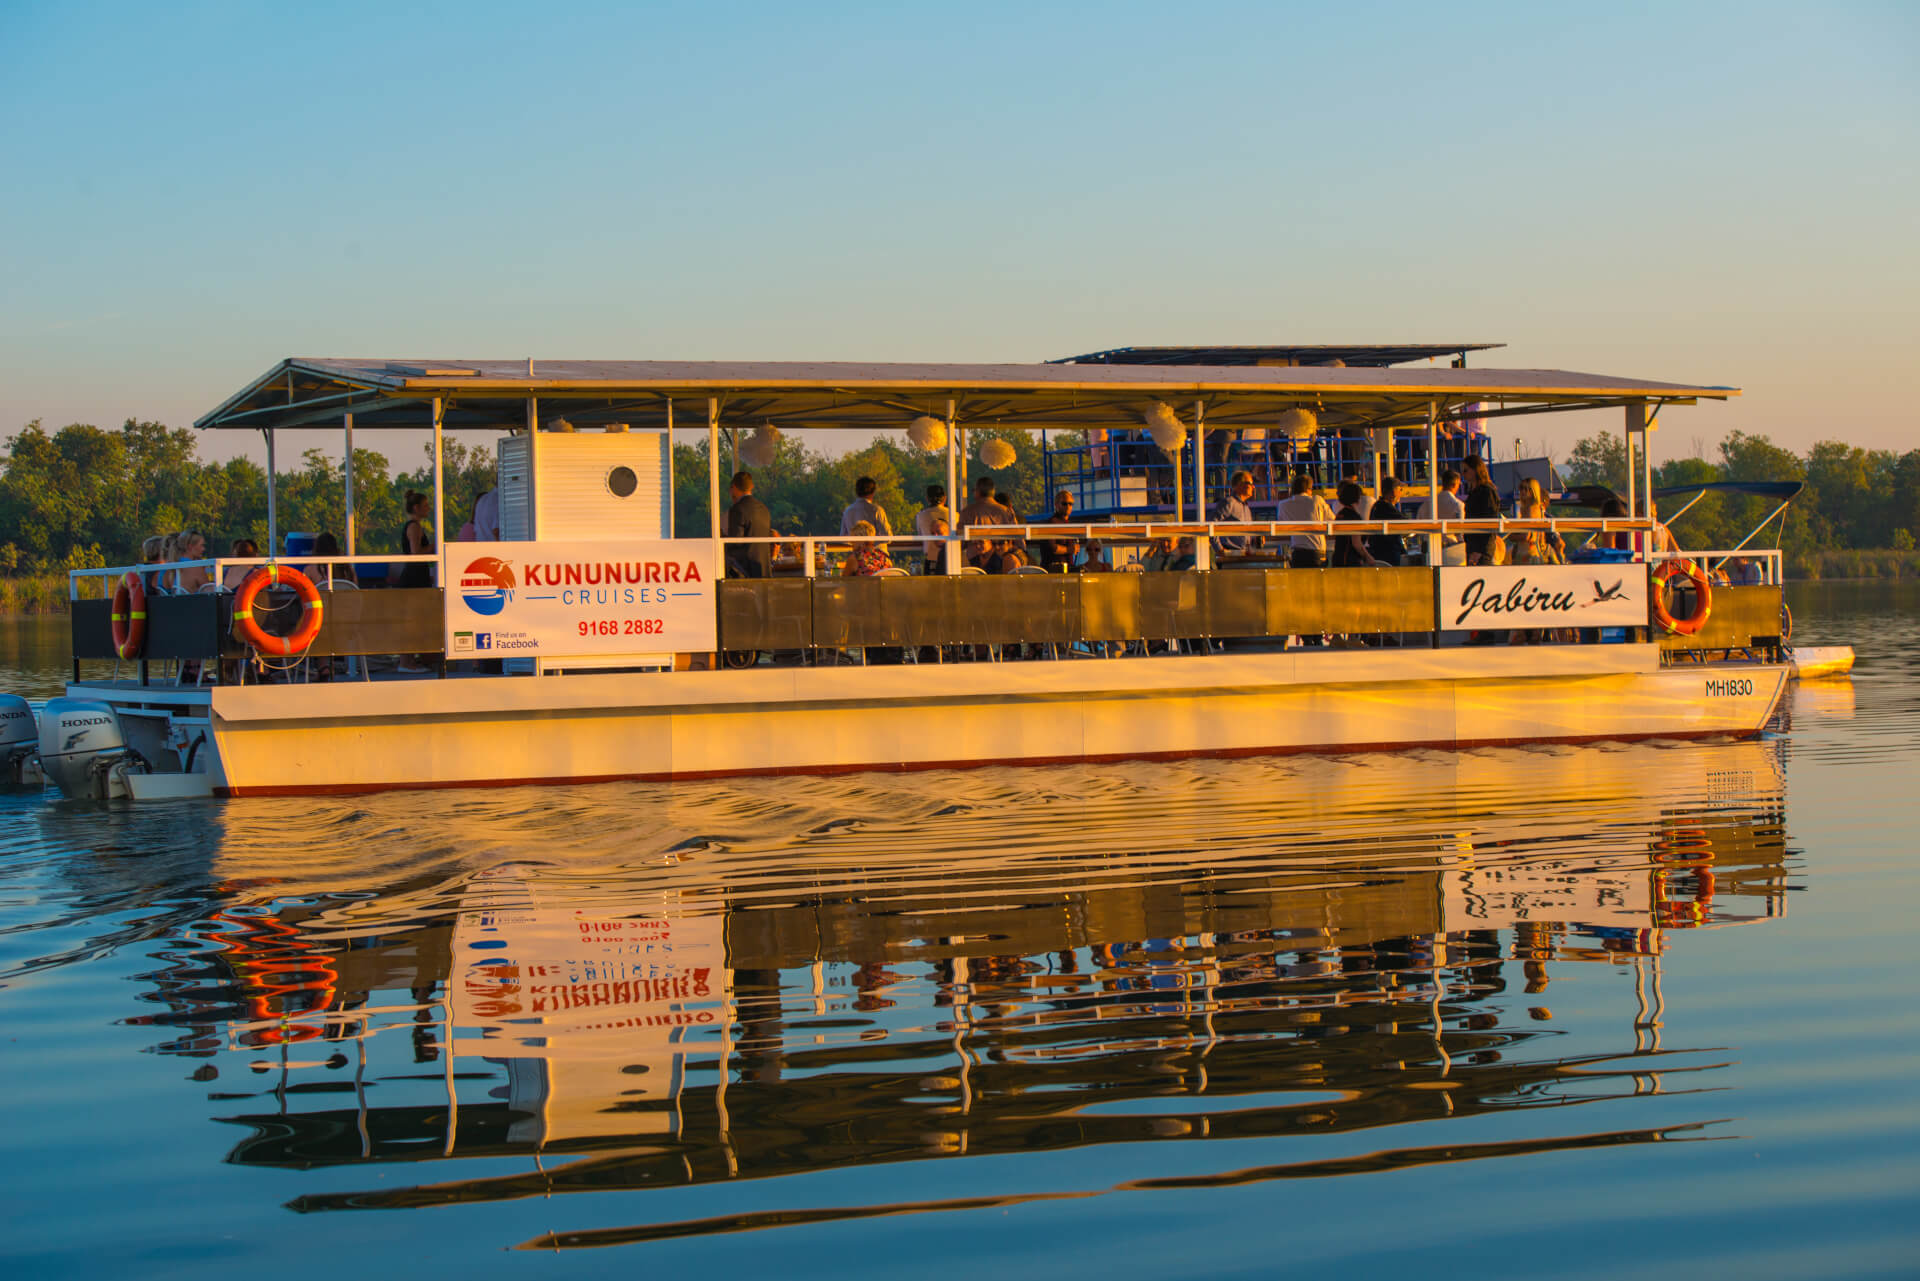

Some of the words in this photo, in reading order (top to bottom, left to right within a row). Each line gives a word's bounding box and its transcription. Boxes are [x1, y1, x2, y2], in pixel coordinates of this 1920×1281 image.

[524, 561, 702, 586] KUNUNURRA
[563, 588, 667, 605] CRUISES
[1456, 577, 1576, 625] Jabiru
[578, 620, 619, 636] 9168
[623, 619, 664, 635] 2882
[496, 638, 539, 649] Facebook
[1705, 679, 1753, 697] MH1830
[61, 717, 113, 728] HONDA
